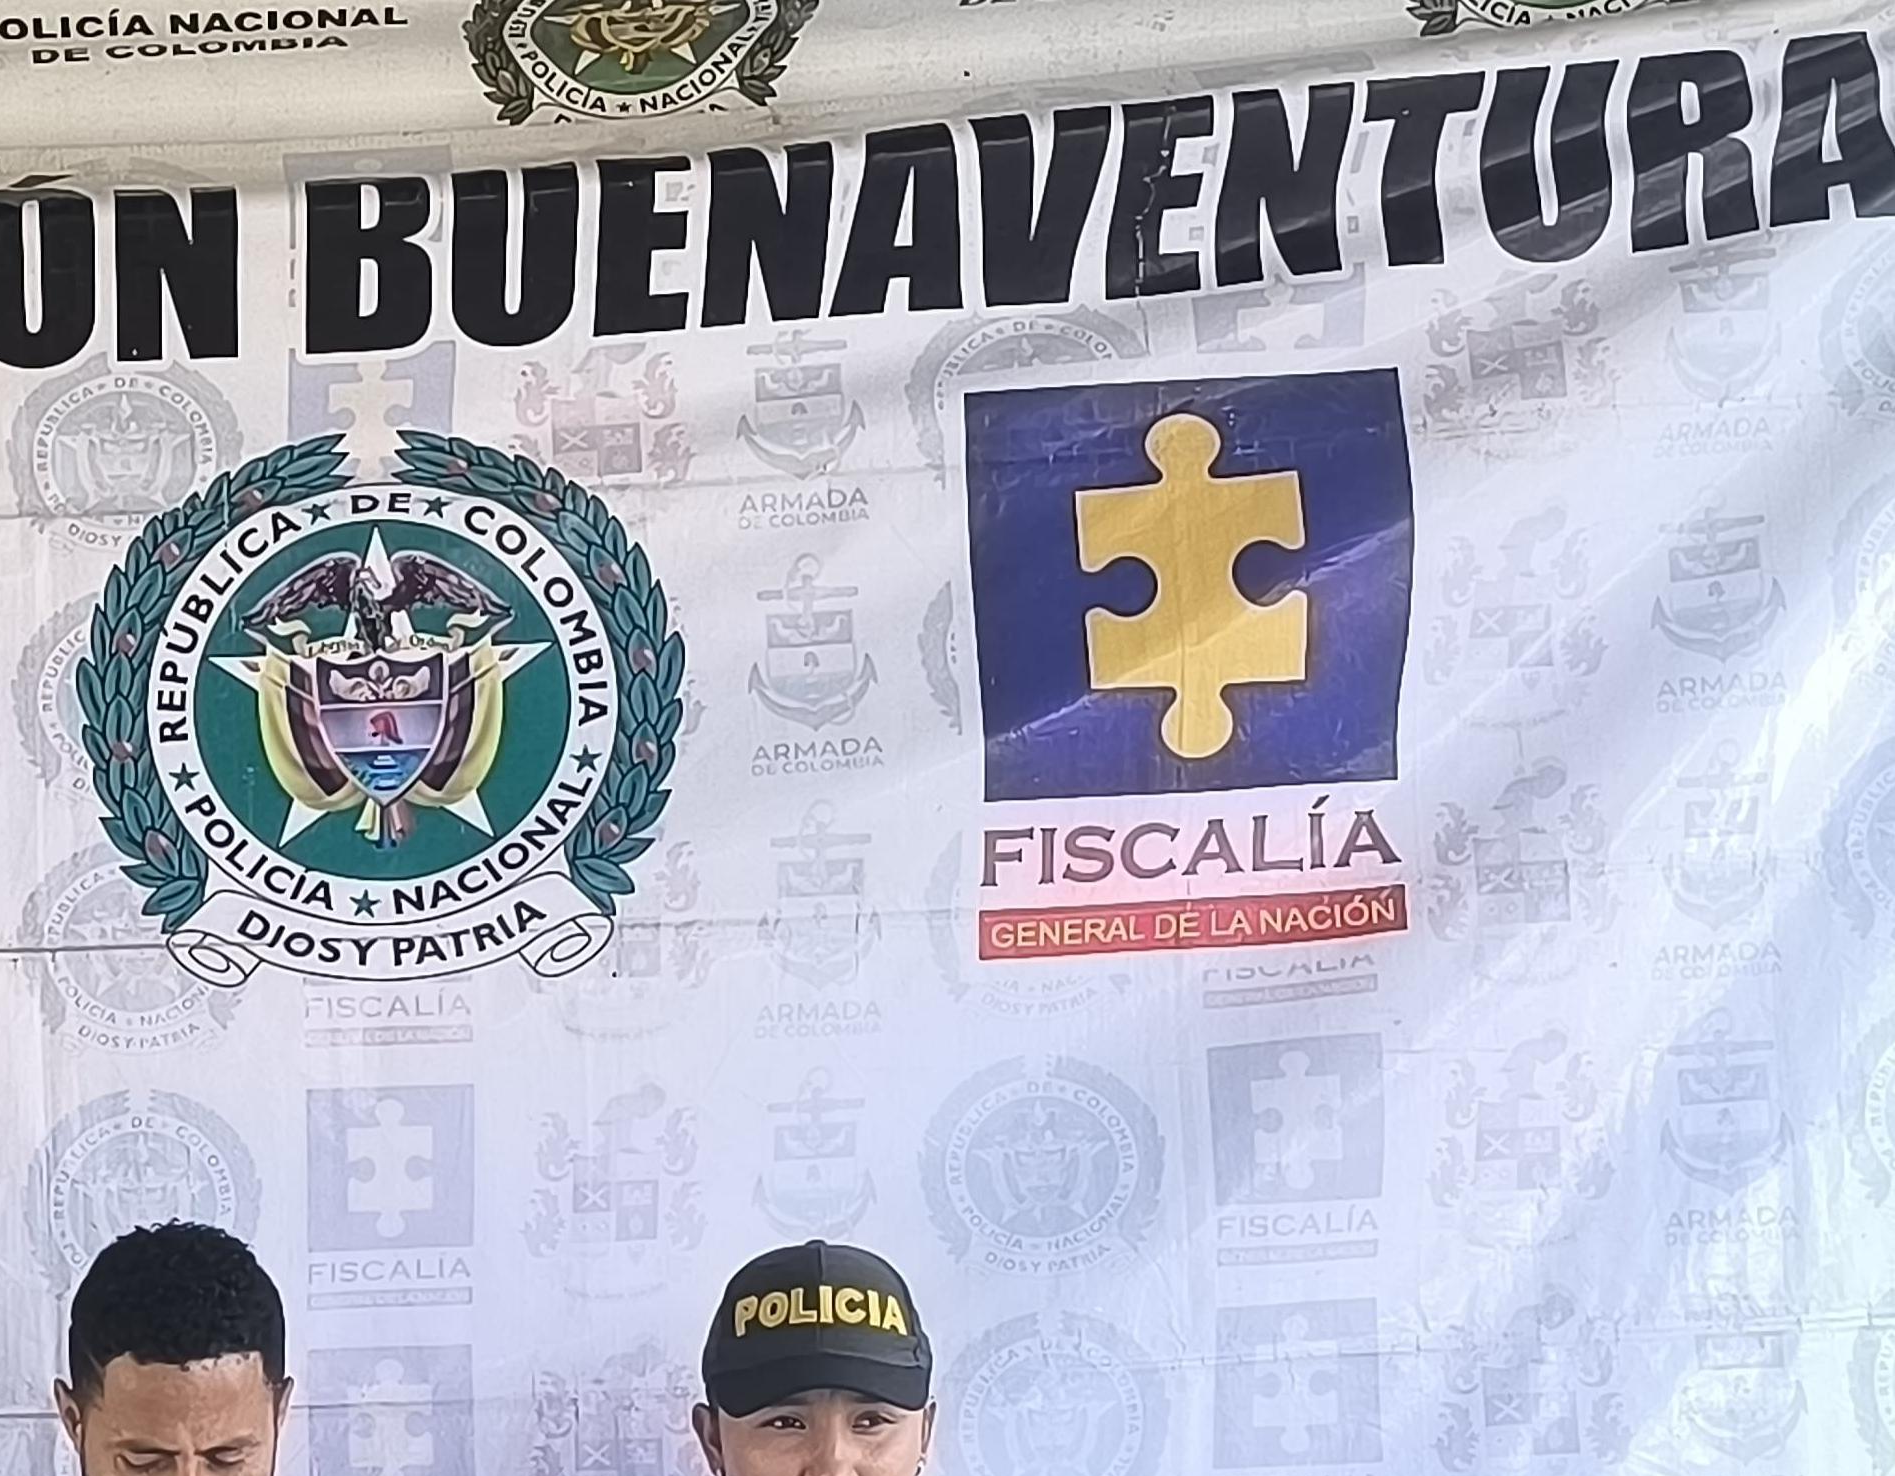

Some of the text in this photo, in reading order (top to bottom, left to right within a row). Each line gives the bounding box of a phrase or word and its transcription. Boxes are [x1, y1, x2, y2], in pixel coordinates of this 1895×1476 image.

[31, 36, 349, 65] DE COLOMBIA
[168, 6, 409, 35] NACIONAL
[641, 27, 754, 114] NACIONAL
[304, 30, 1895, 355] BUENAVENTURA
[738, 485, 870, 513] ARMADA
[351, 492, 413, 516] DE
[464, 505, 609, 727] COLOMBIA
[751, 735, 884, 762] ARMADA
[393, 776, 594, 915] NACIONAL
[980, 795, 1402, 887] FISCALÍA
[394, 899, 547, 967] PATRIA
[991, 890, 1395, 949] GENERAL DE LA NACIÓN
[734, 1285, 908, 1337] POLICIA
